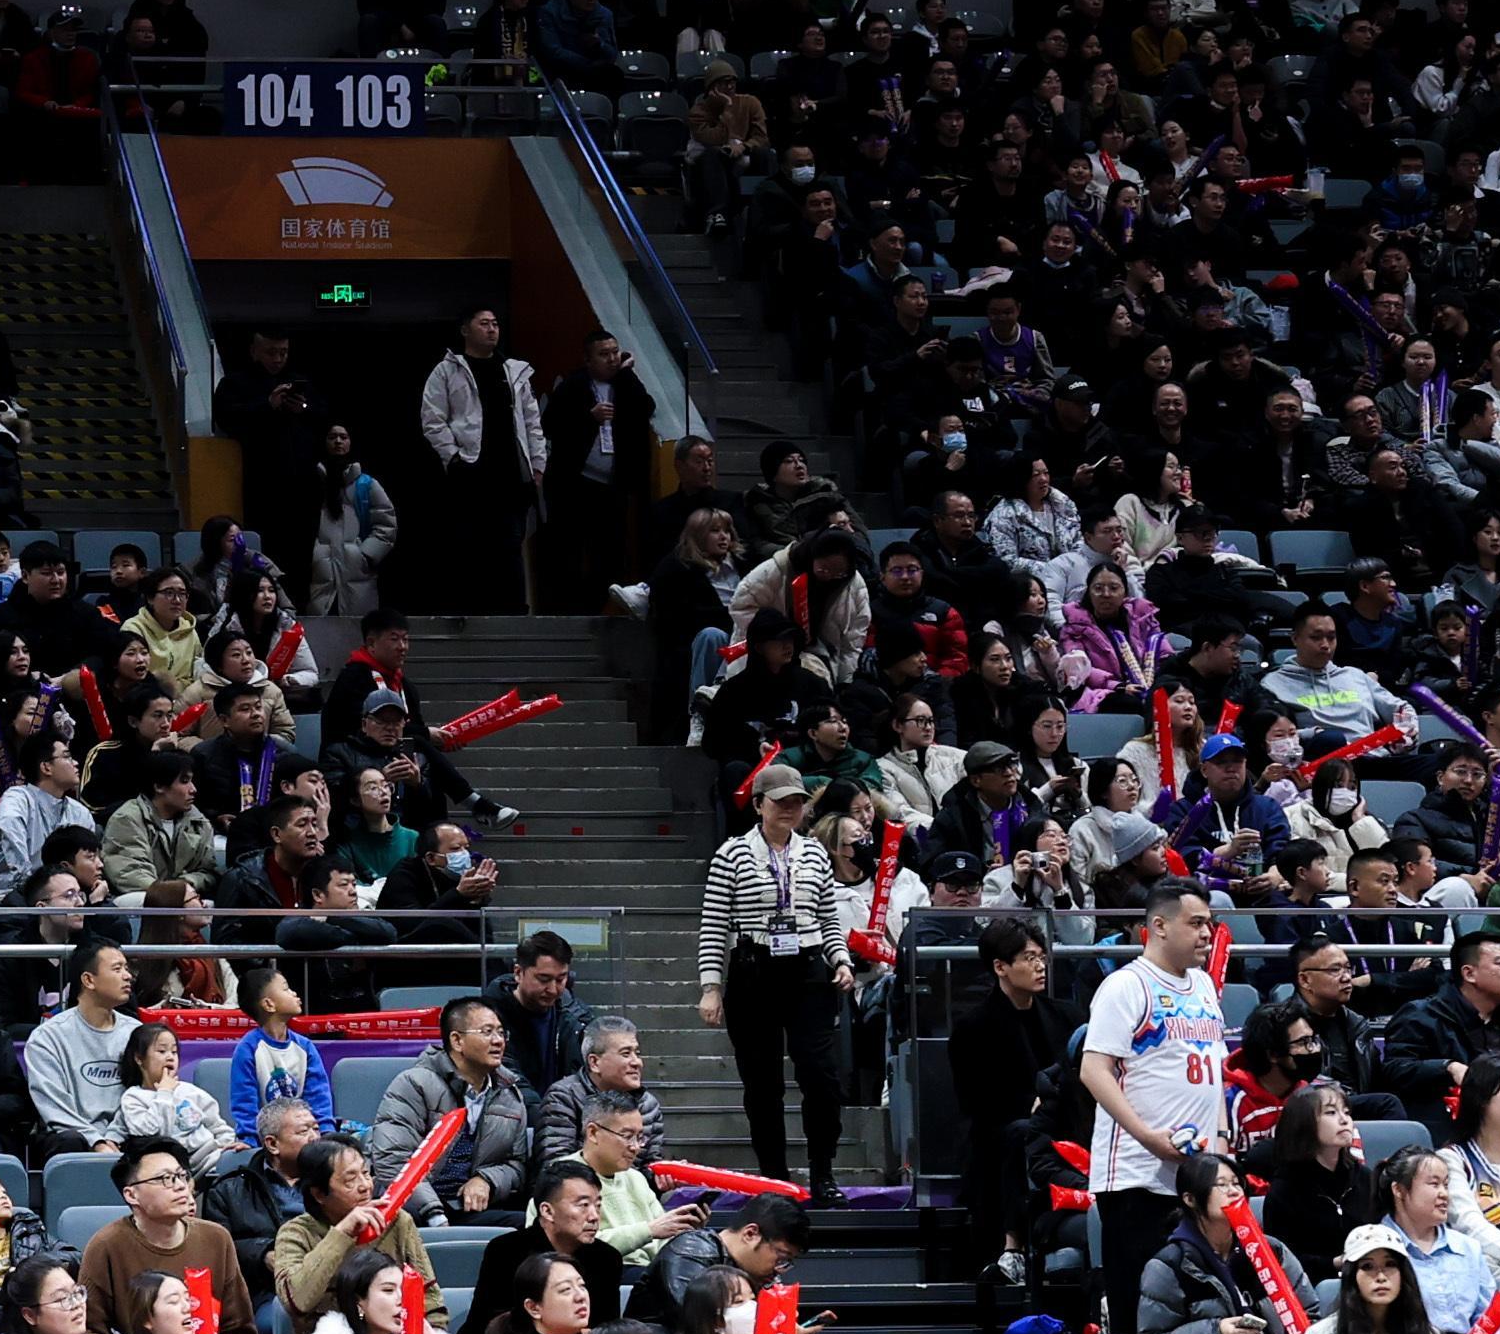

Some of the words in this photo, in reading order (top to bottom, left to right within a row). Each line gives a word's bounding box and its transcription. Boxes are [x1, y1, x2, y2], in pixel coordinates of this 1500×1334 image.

[236, 73, 314, 129] 104
[335, 72, 413, 130] 103
[279, 216, 392, 240] 国家体育馆
[1186, 1053, 1214, 1085] 81
